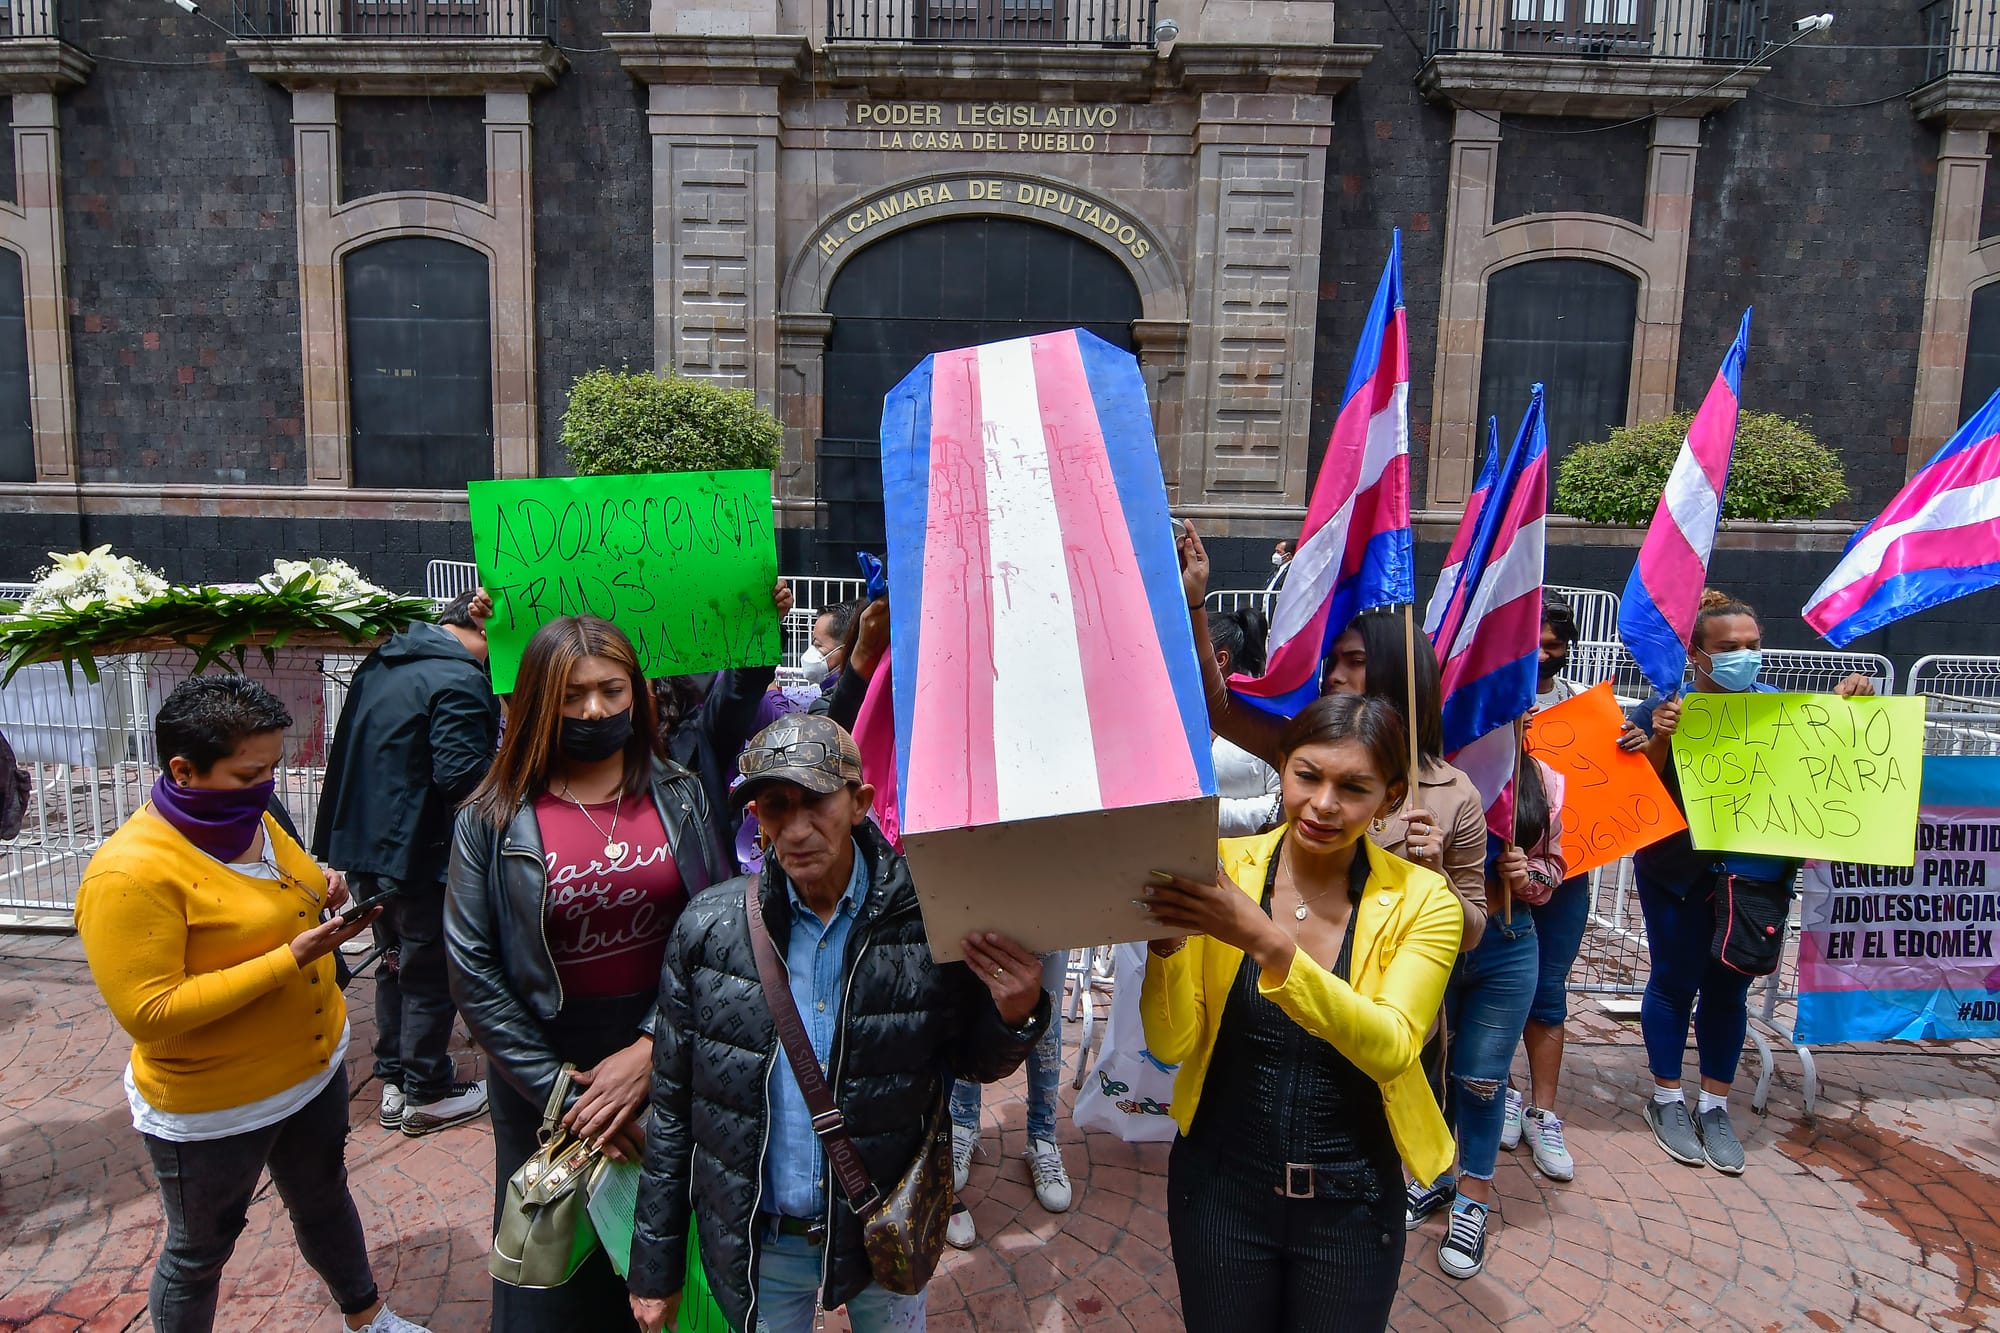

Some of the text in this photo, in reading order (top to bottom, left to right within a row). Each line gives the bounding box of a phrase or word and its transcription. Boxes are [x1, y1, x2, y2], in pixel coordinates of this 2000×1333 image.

[856, 104, 1118, 128] PODER LEGISLATIVO
[879, 131, 1096, 152] LA CASA DEL PUEBLO
[818, 180, 1151, 260] H. CAMARA DE DIPUTADOS
[492, 492, 769, 569] ADOLESCENCIA
[491, 571, 656, 631] TRANS
[1682, 697, 1892, 756] SALARIO
[1677, 747, 1907, 794] ROSA PARA
[1690, 793, 1861, 840] TRANS
[1923, 859, 1986, 887] PARA
[1830, 893, 2000, 925] ADOLESCENCIA
[1826, 922, 1993, 960] EN EL EDOMÉX
